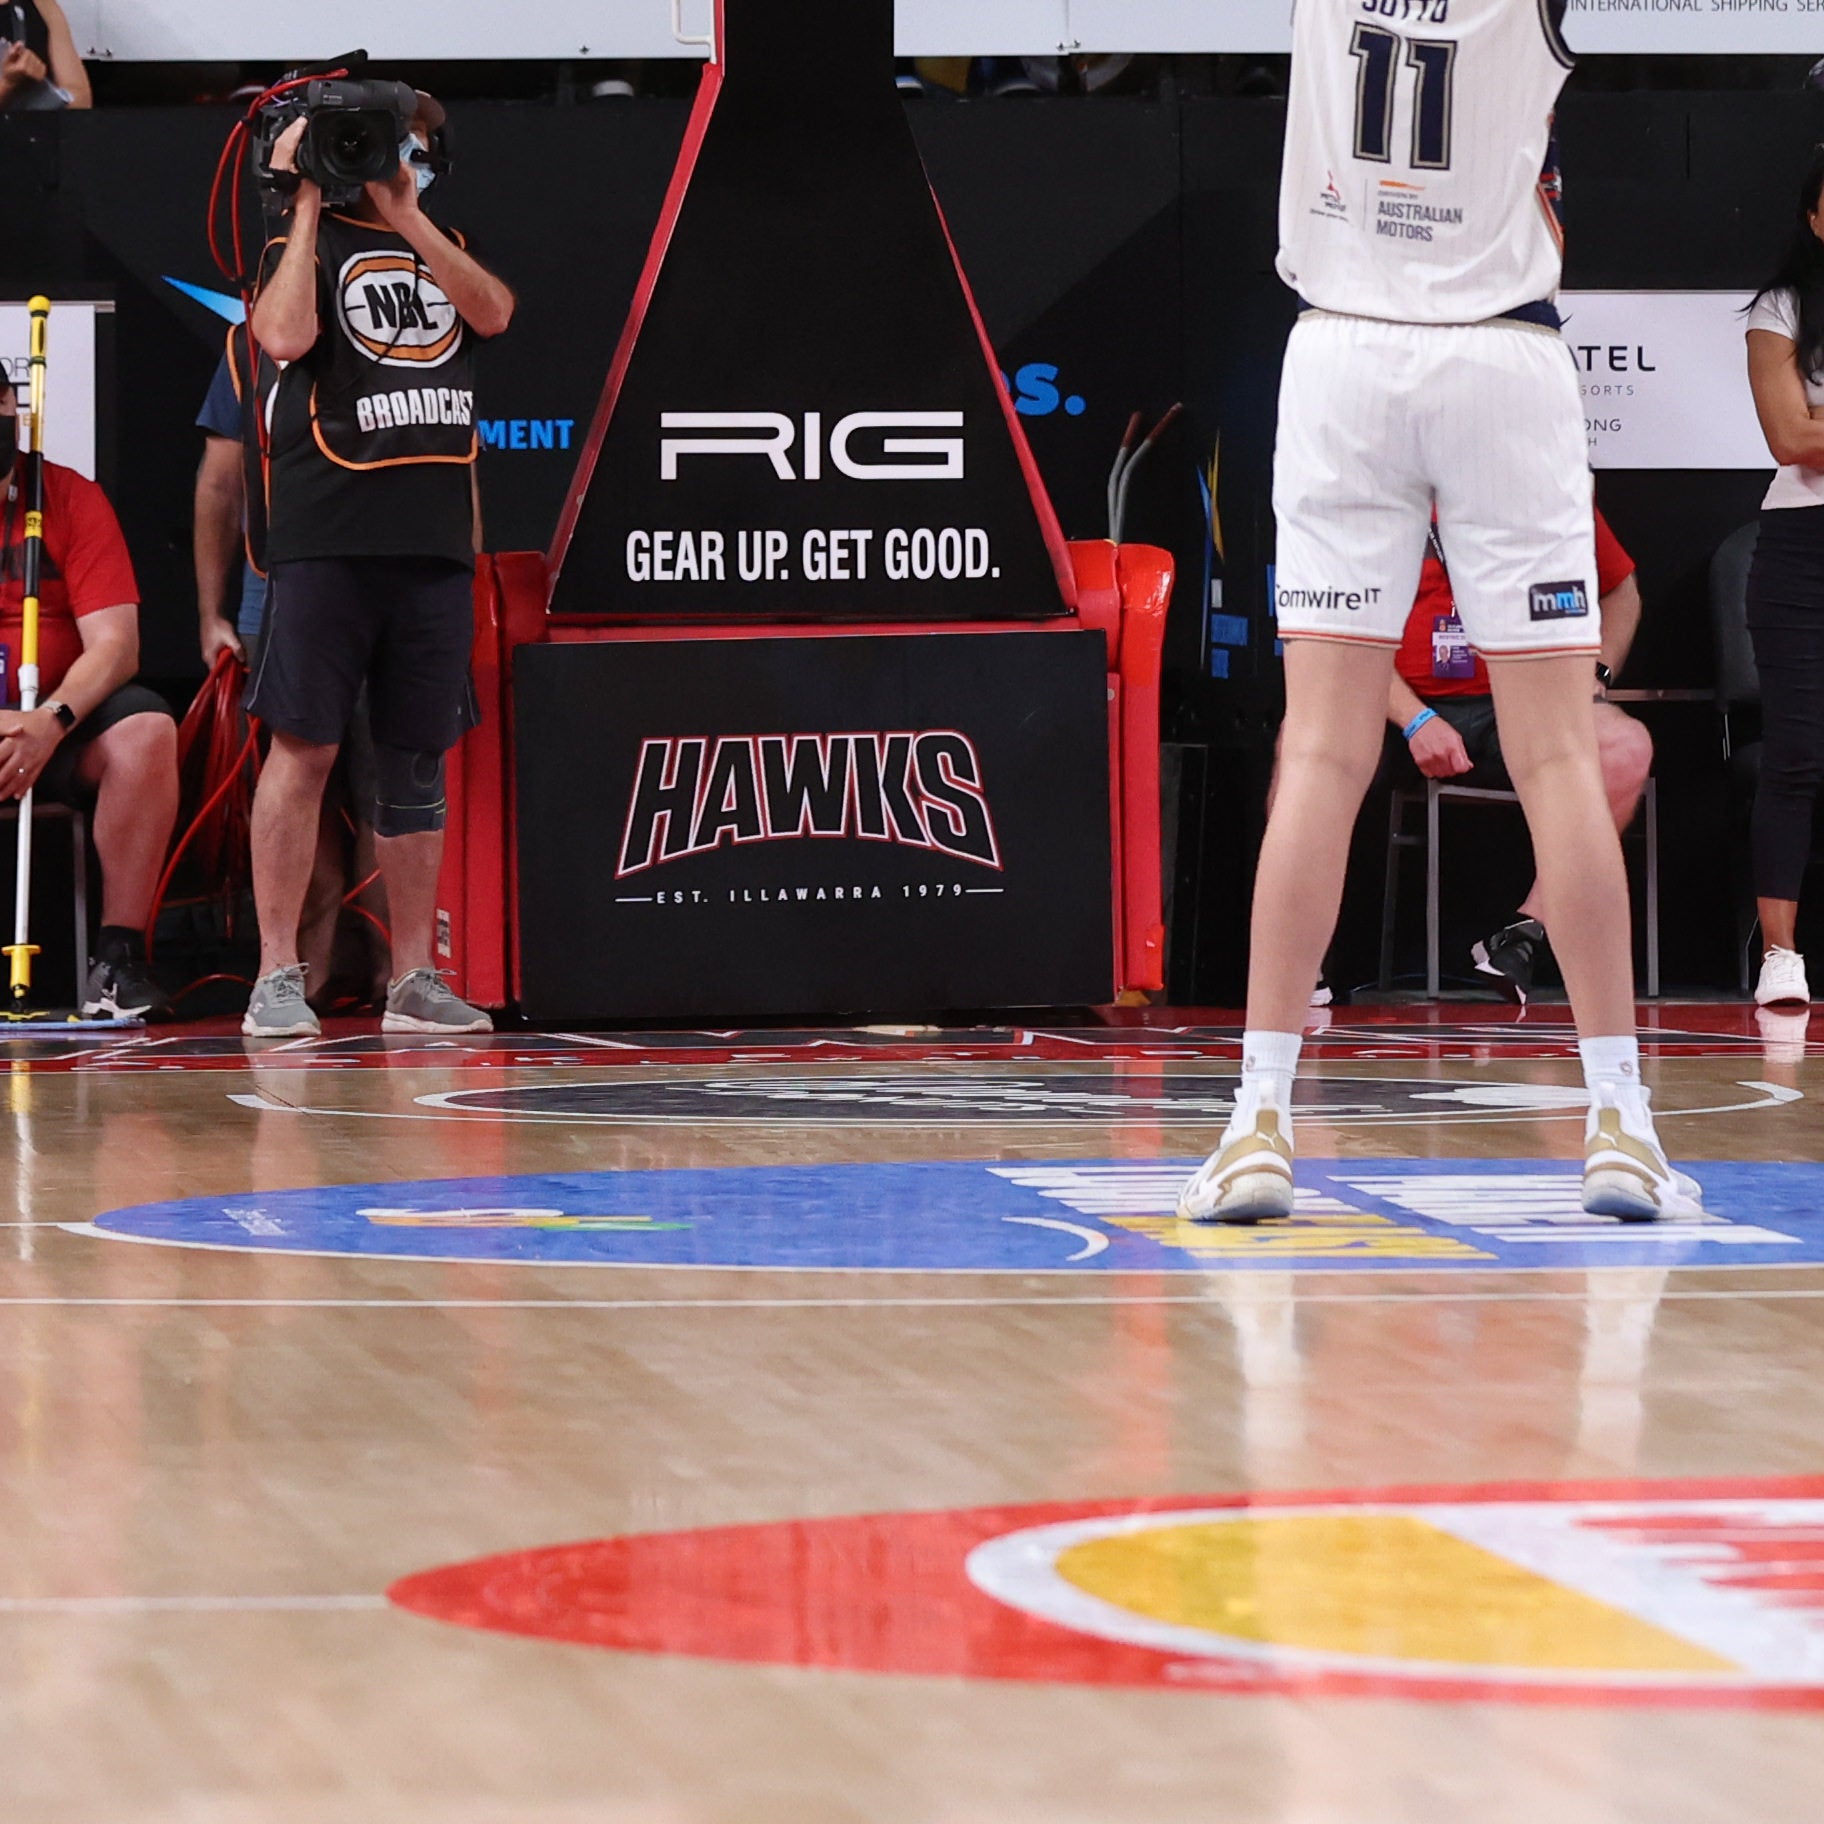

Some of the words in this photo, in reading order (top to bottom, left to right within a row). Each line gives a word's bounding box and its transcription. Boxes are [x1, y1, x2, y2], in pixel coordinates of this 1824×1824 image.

[1348, 20, 1458, 172] 11
[1376, 219, 1433, 242] MOTORS
[1377, 200, 1464, 225] AUSTRALIAN
[364, 280, 438, 332] NBL
[660, 411, 964, 481] RIG
[626, 529, 726, 583] GEAR
[737, 530, 790, 582] UP.
[802, 530, 873, 582] GET
[884, 528, 1001, 580] GOOD.
[1533, 587, 1587, 614] mmh
[614, 730, 1005, 879] HAWKS
[656, 889, 710, 904] EST.
[729, 884, 883, 903] ILLAWARRA
[902, 881, 963, 898] 1979
